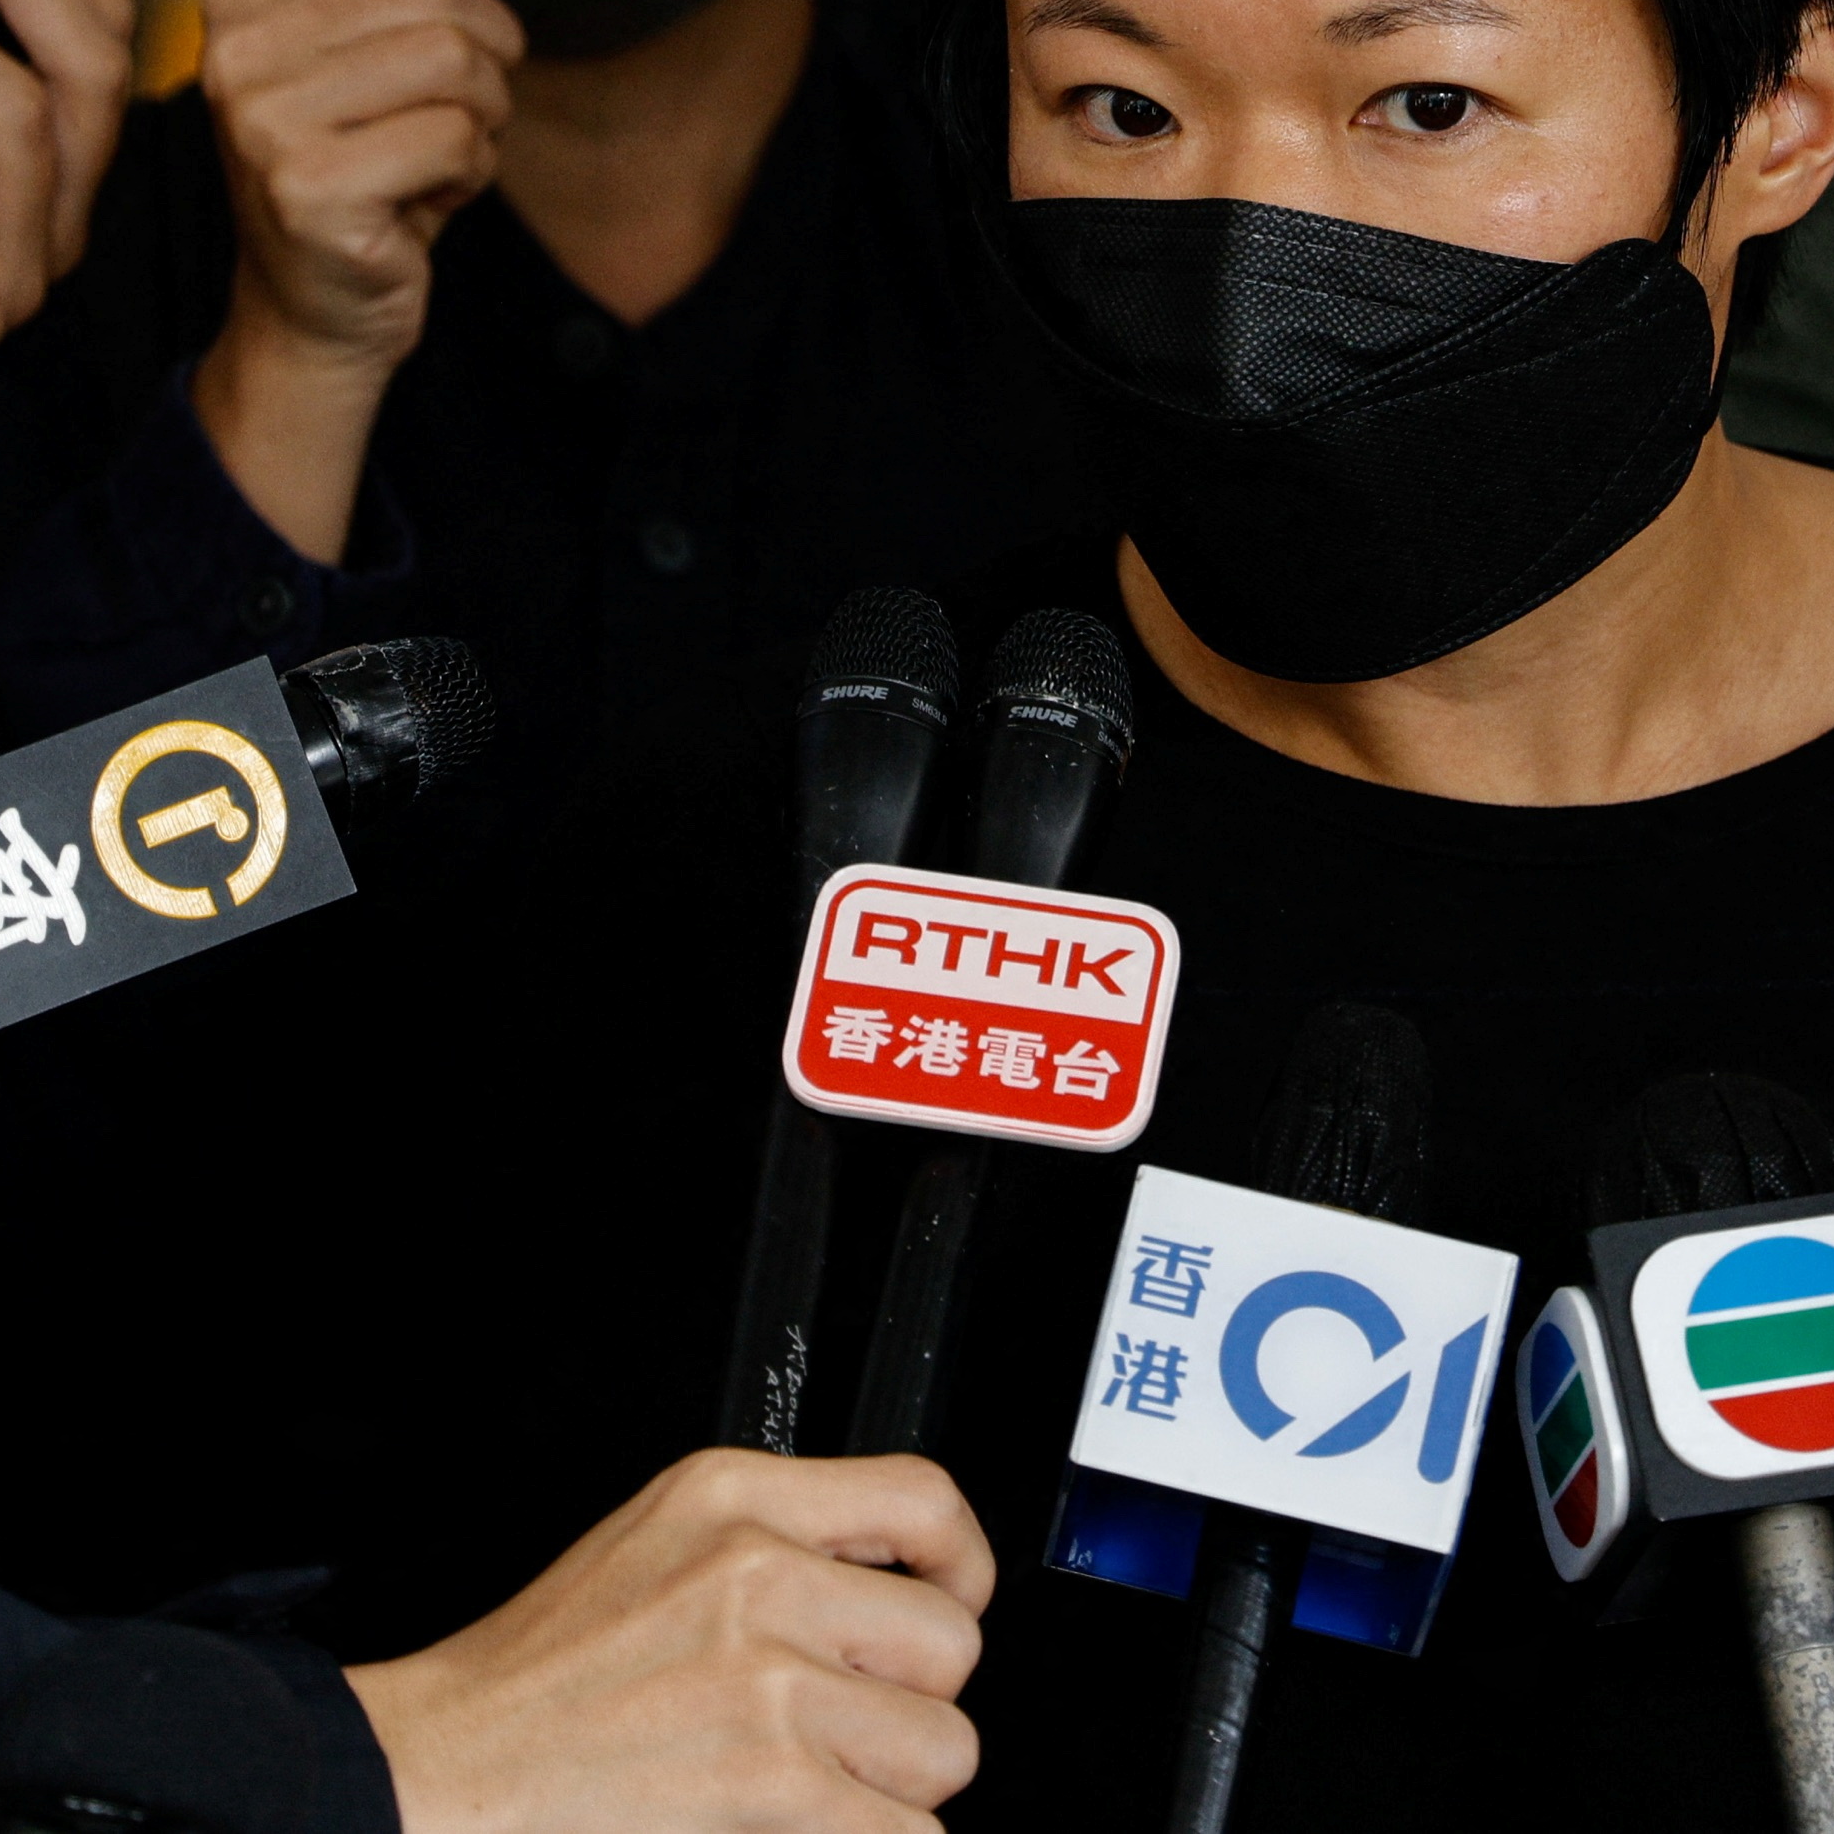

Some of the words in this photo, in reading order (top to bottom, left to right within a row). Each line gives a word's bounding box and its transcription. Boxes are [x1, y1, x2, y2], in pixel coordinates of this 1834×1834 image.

[821, 684, 889, 702] SHURE
[1008, 705, 1078, 728] SHURE
[851, 911, 1136, 997] RTHK
[822, 1005, 1121, 1100] 香港電台
[1100, 1234, 1215, 1422] 香港
